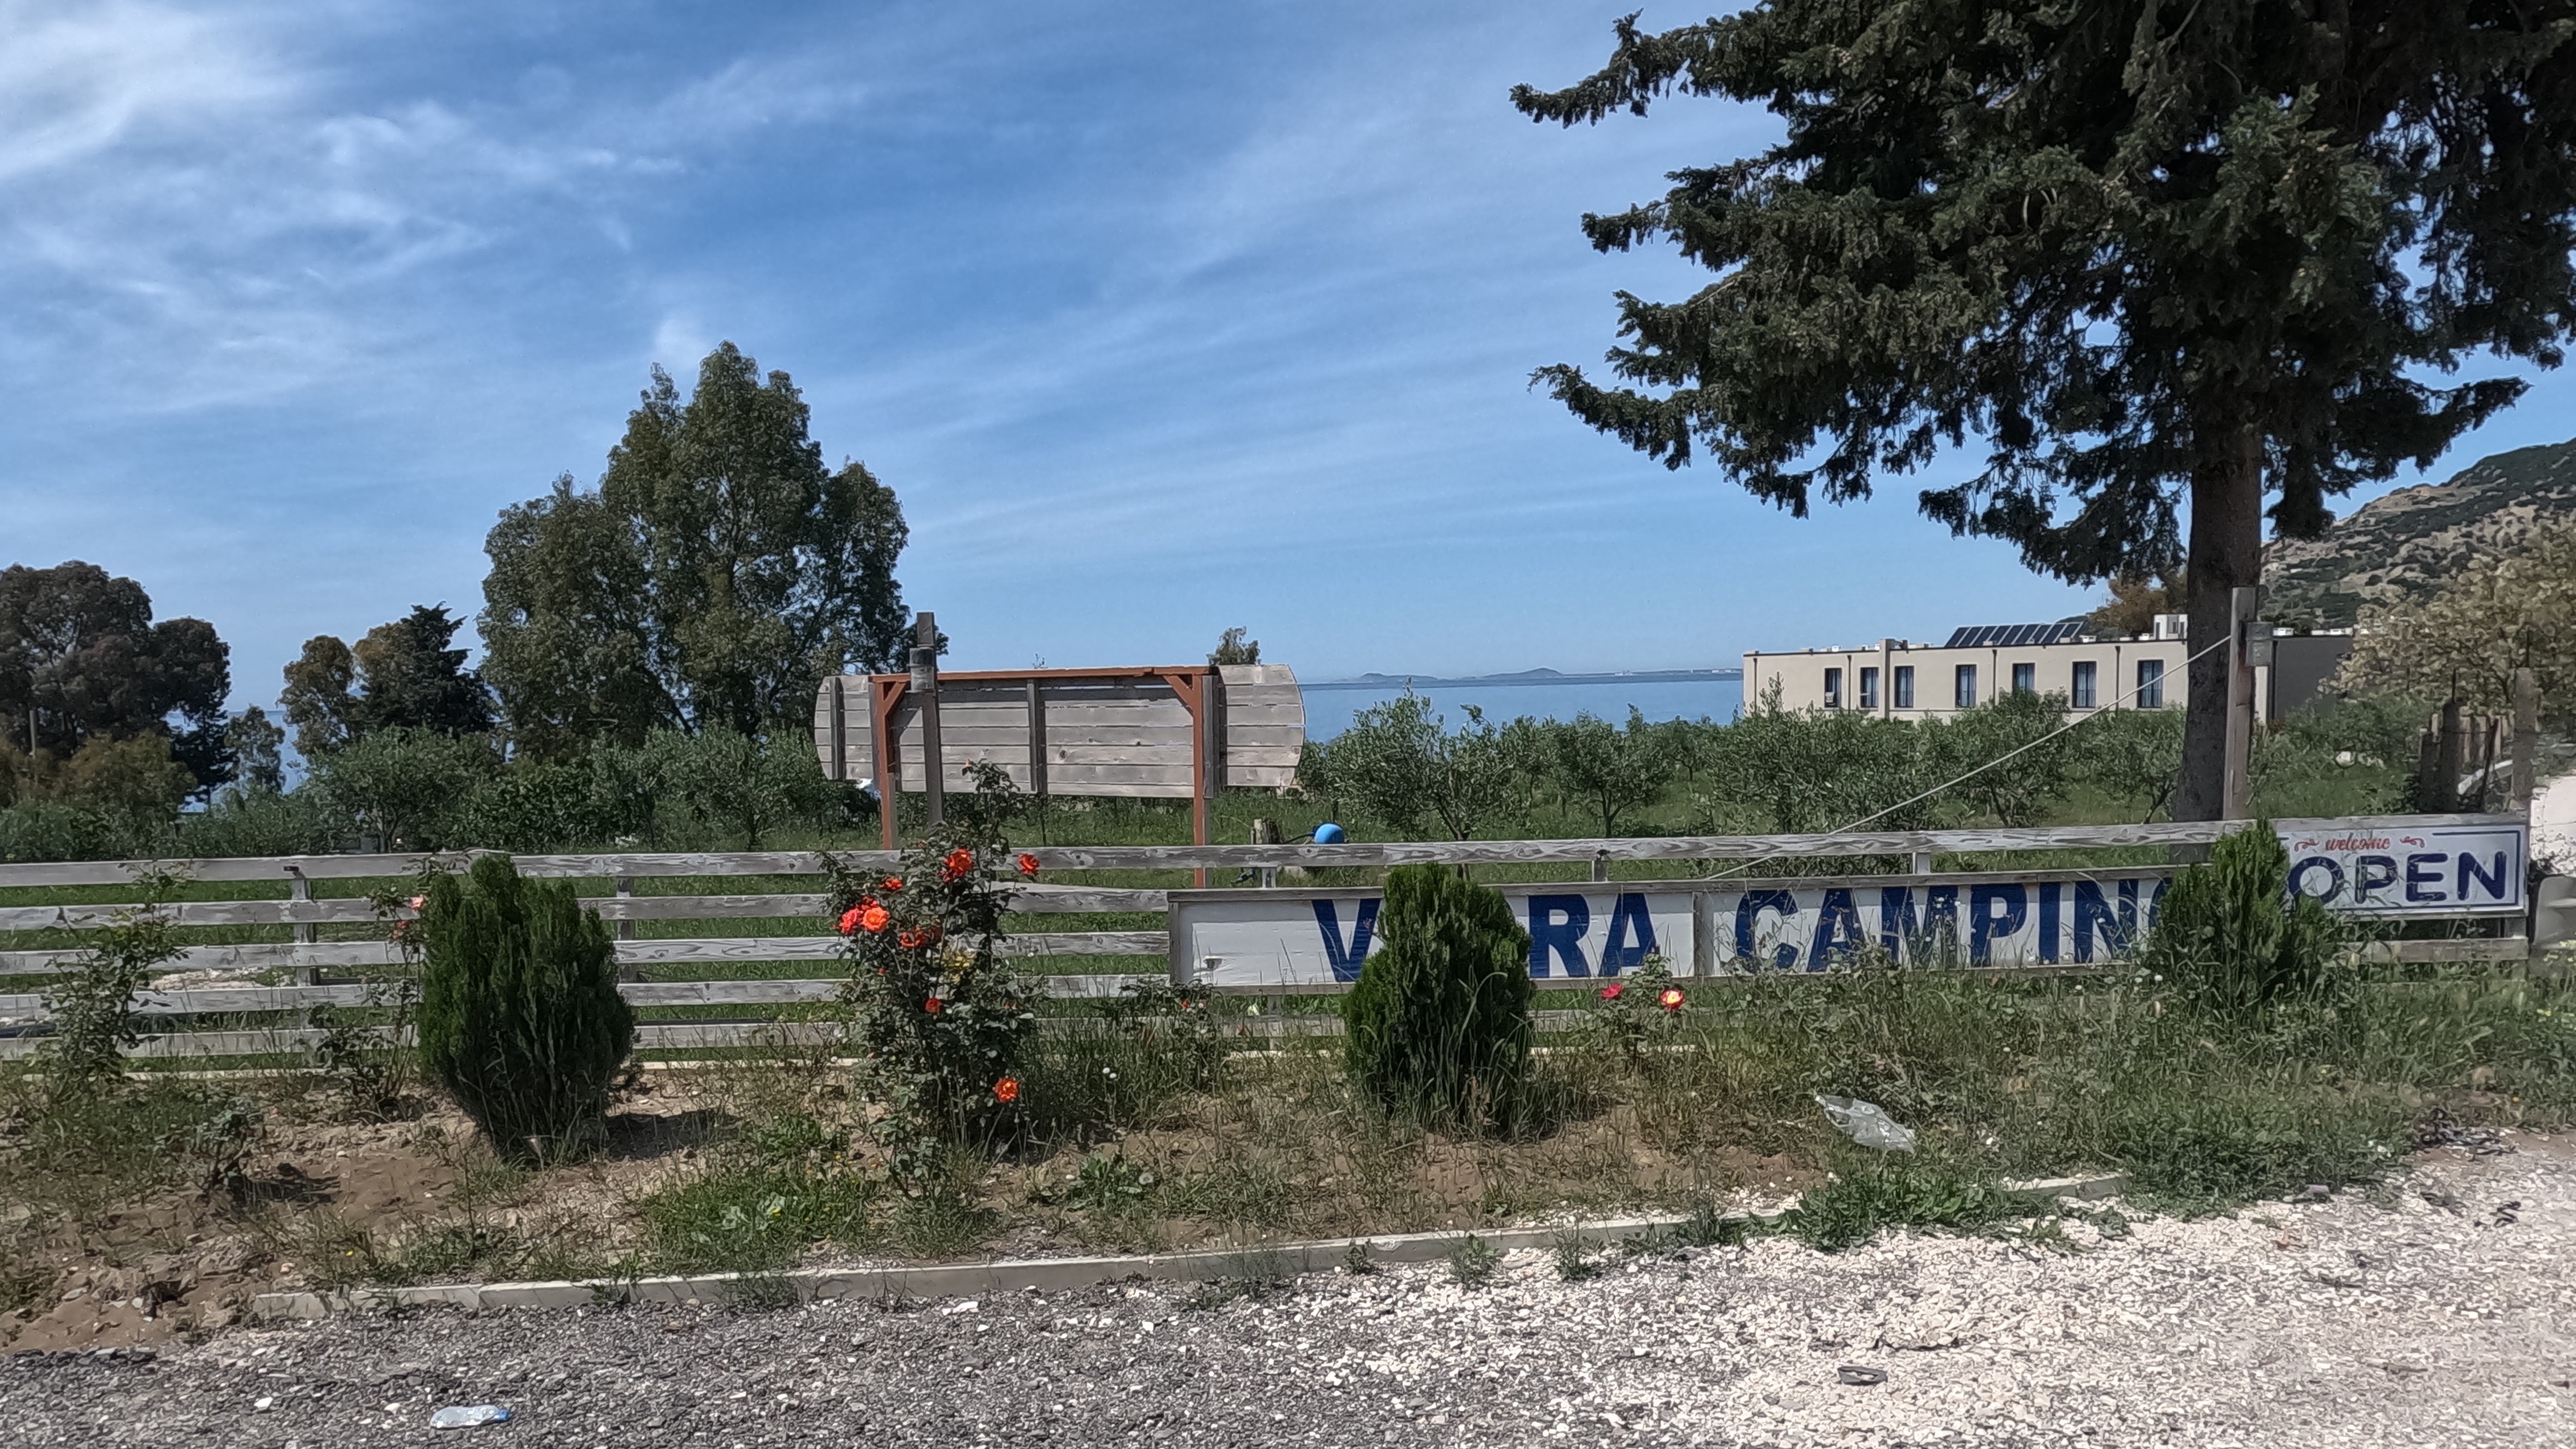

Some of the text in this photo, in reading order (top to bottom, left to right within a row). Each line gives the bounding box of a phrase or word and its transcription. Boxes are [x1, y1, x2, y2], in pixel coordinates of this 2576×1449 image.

[2325, 832, 2390, 851] welcome
[2288, 851, 2508, 904] OPEN
[1312, 878, 2174, 982] VRA CAMPIN
